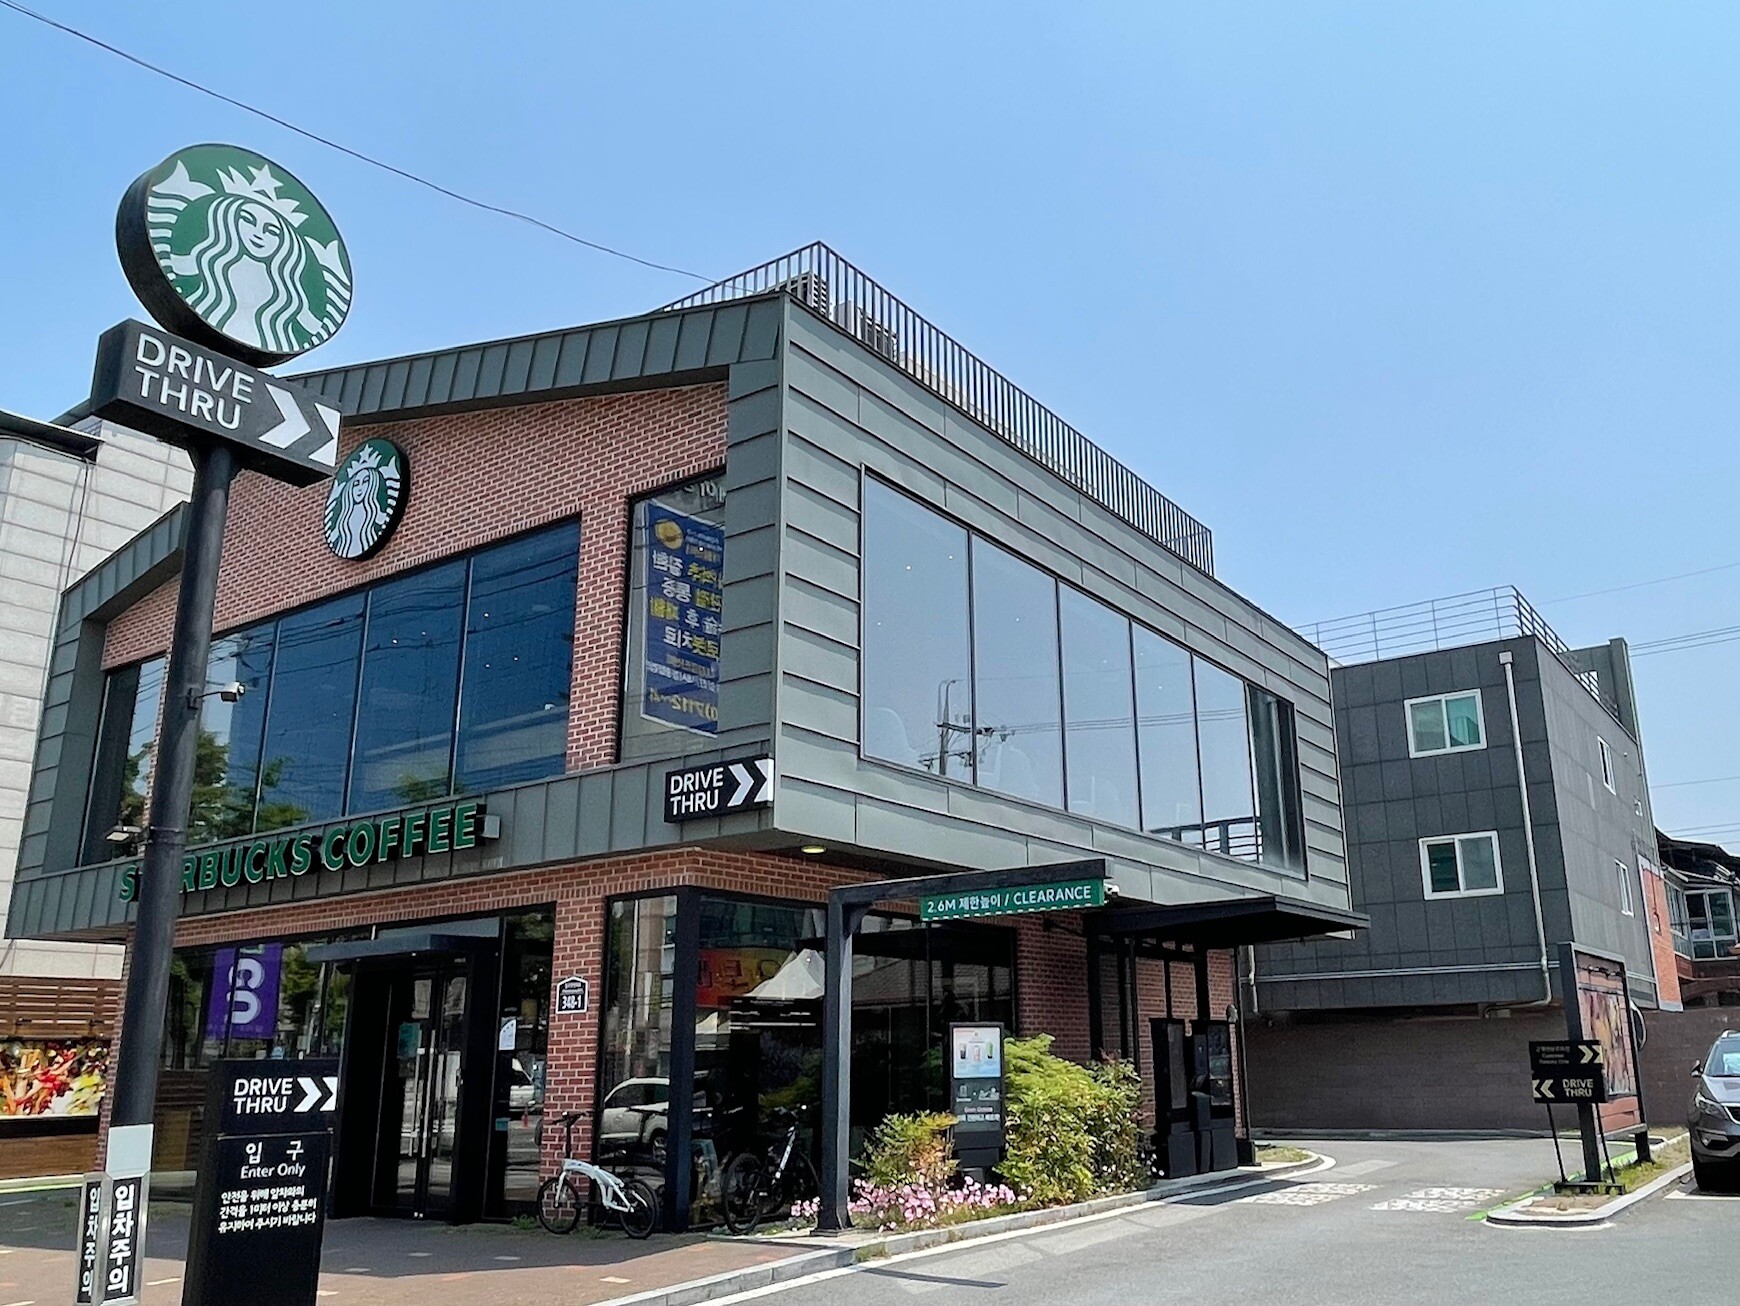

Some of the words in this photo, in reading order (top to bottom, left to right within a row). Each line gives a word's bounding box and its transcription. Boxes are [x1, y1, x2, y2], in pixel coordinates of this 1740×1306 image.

[137, 332, 255, 404] DRIVE
[135, 366, 242, 430] THRU
[670, 767, 724, 794] DRIVE
[670, 788, 719, 816] THRU
[119, 833, 312, 902] SRBUCKS
[322, 804, 477, 871] COFFEE
[927, 900, 956, 914] 2.6M
[958, 894, 1001, 910] 제한높이
[1013, 886, 1092, 906] CLEARANCE
[234, 1077, 293, 1097] DRIVE
[1562, 1078, 1594, 1088] DRIVE
[1564, 1088, 1592, 1098] THRU
[234, 1096, 287, 1114] THRU
[240, 1166, 275, 1179] Enter
[277, 1163, 306, 1178] Only
[221, 1190, 248, 1204] 안전을
[220, 1204, 248, 1219] 간격을
[272, 1201, 290, 1213] 이상
[255, 1216, 282, 1229] 주시기
[282, 1212, 316, 1226] 바랍니다
[107, 1184, 134, 1293] 입차주의
